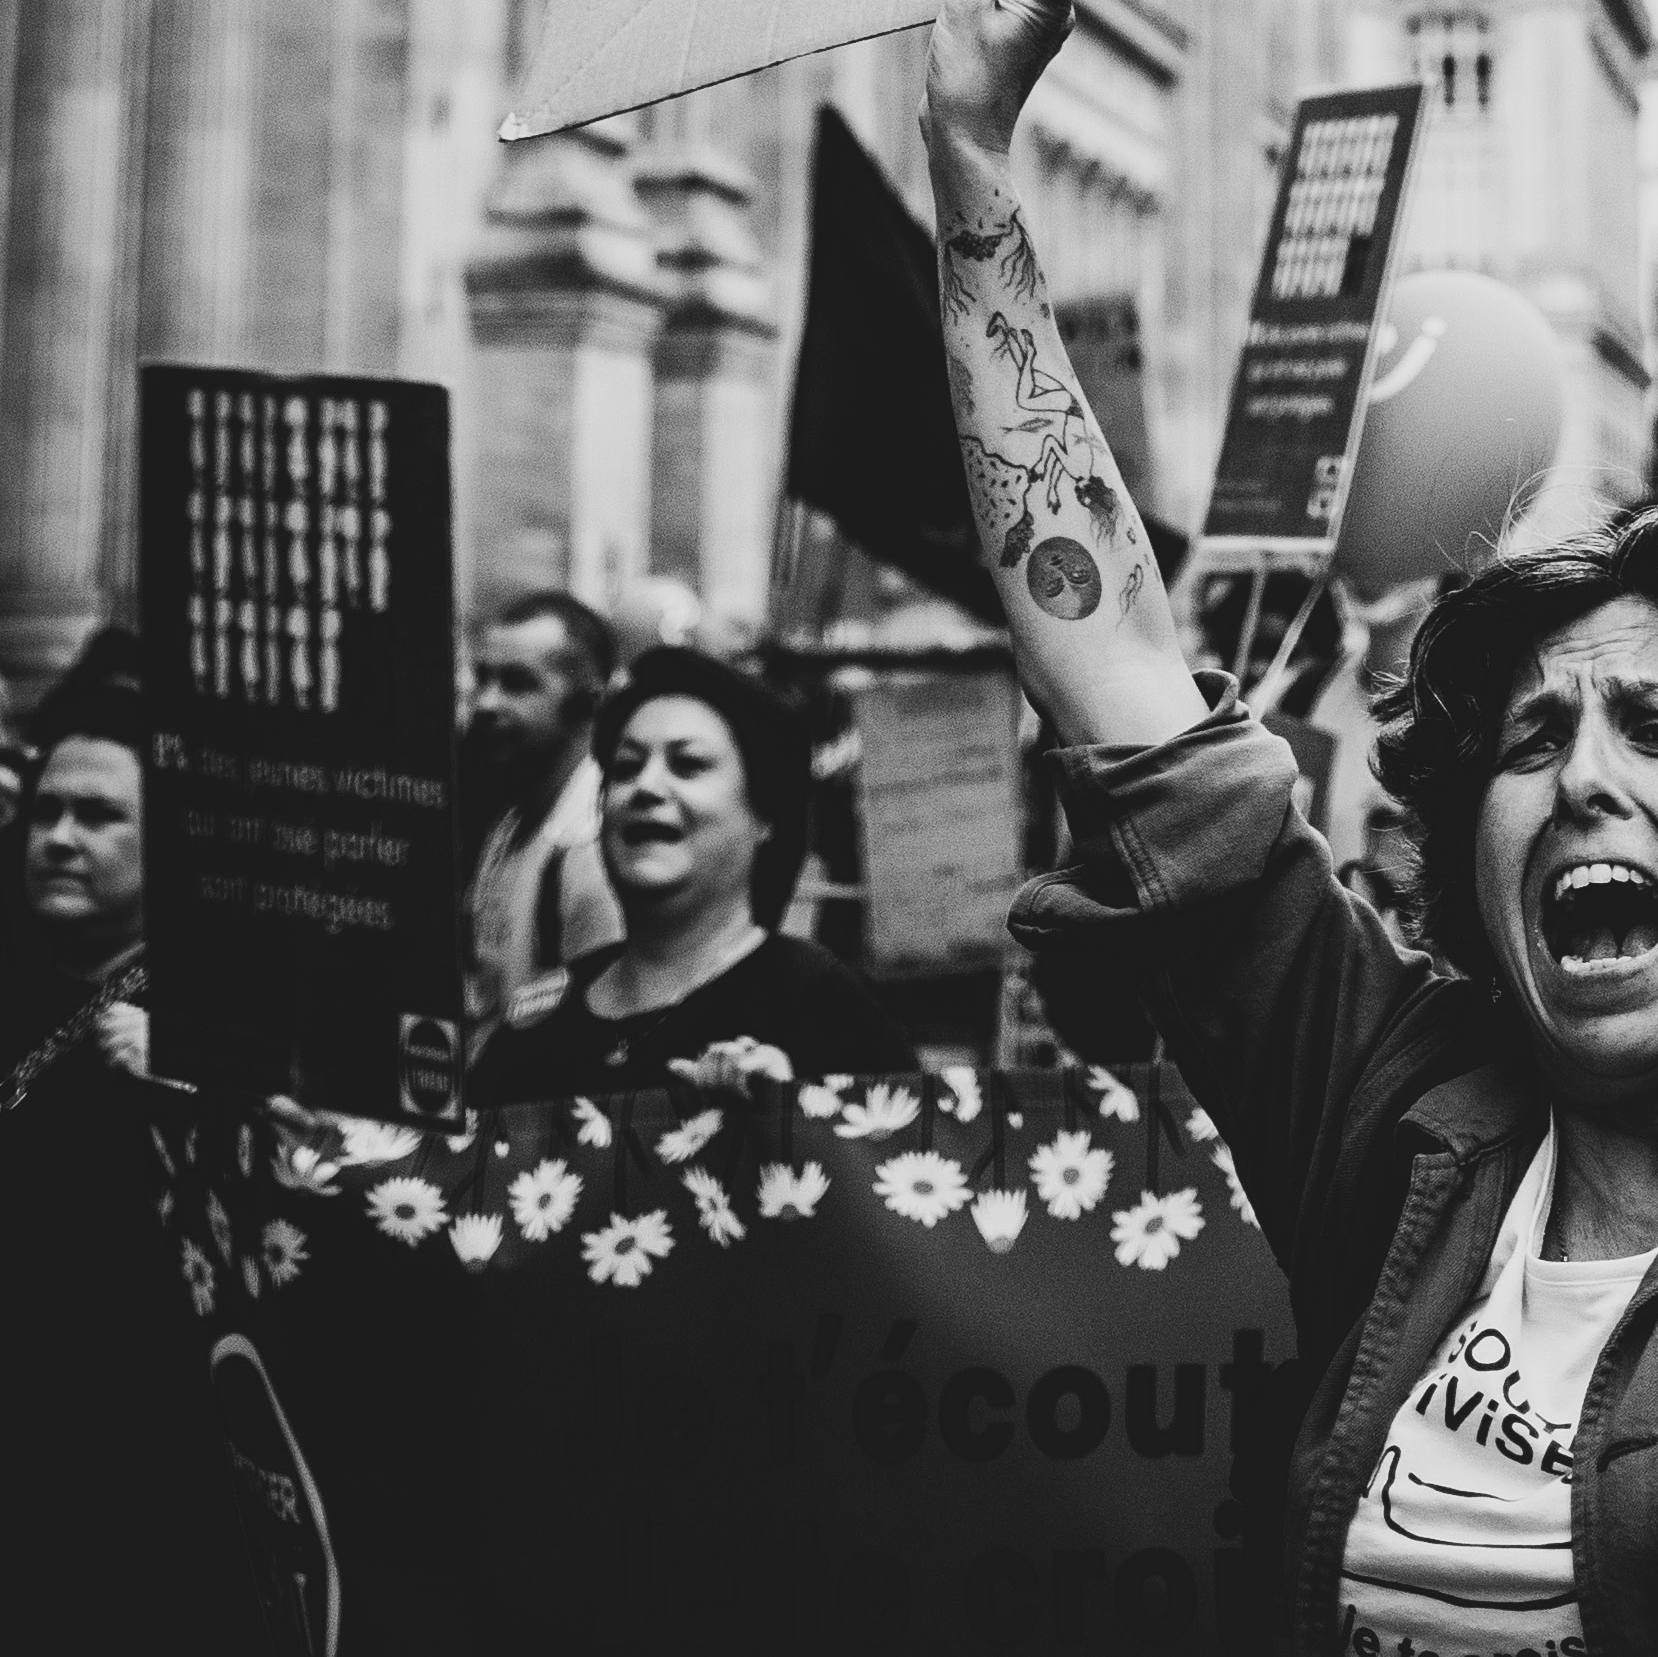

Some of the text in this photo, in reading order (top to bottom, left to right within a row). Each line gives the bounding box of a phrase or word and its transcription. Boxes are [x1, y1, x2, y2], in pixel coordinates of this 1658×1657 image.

[335, 765, 447, 809] victimes
[758, 1312, 1272, 1467] t'écout
[963, 1500, 1246, 1649] croi
